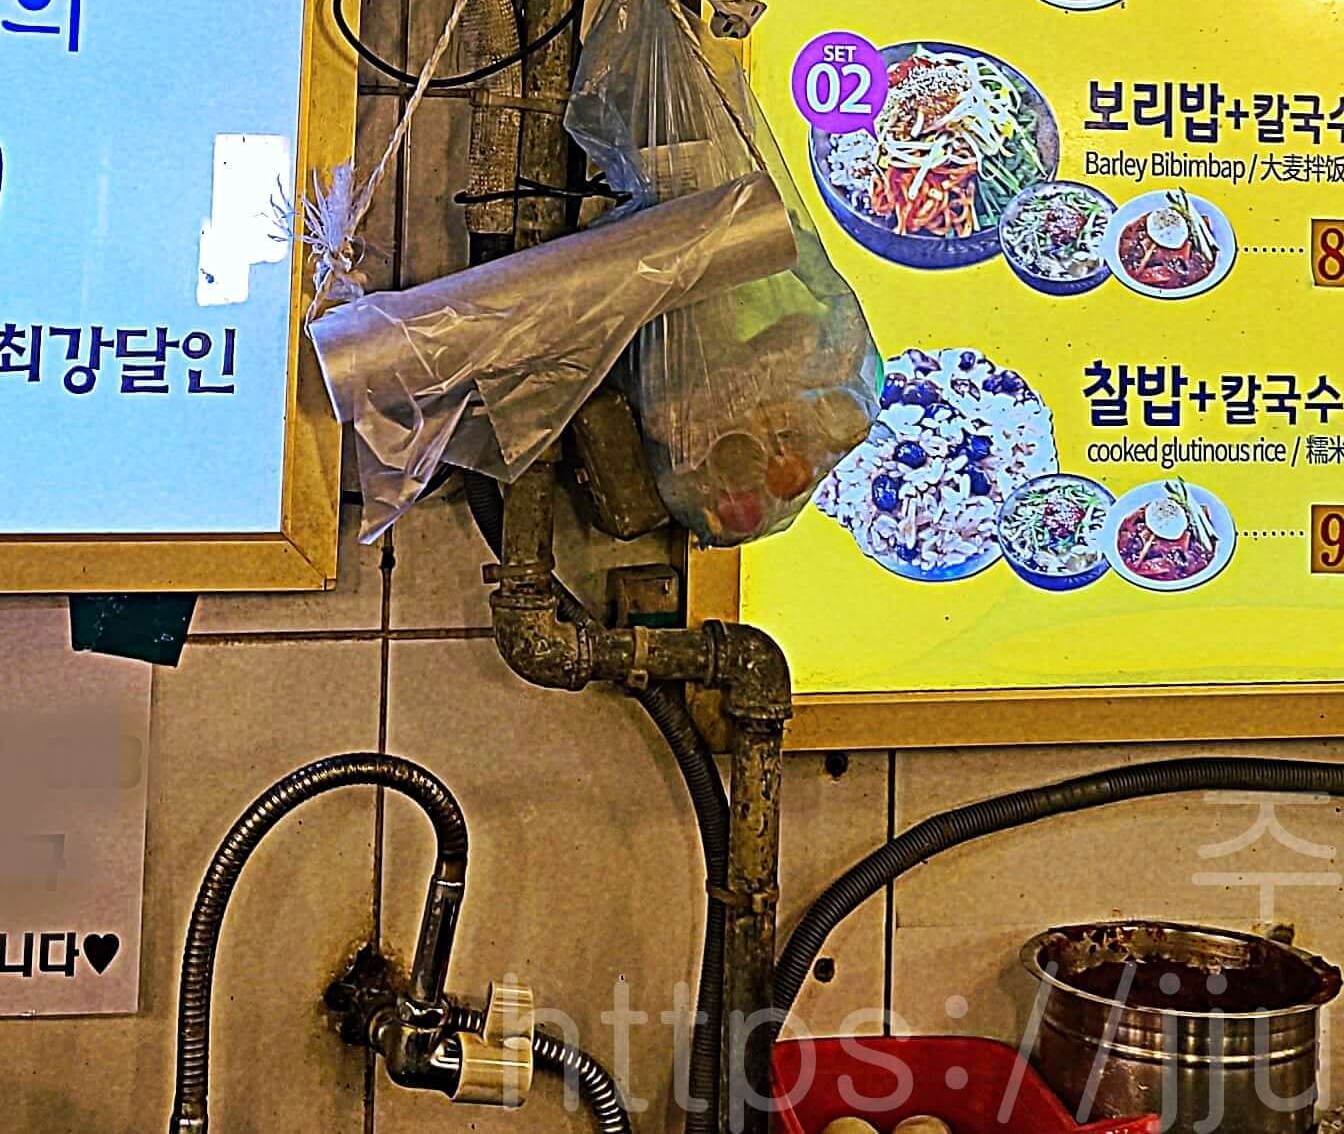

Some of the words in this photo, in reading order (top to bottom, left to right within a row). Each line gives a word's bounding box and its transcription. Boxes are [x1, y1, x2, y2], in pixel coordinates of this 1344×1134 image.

[823, 44, 857, 63] SET
[805, 63, 874, 116] 02
[1085, 150, 1148, 184] Barley
[1151, 152, 1246, 186] Bibimbap
[1087, 436, 1158, 463] cooked
[1161, 436, 1251, 469] glutinous
[1252, 437, 1287, 463] rice
